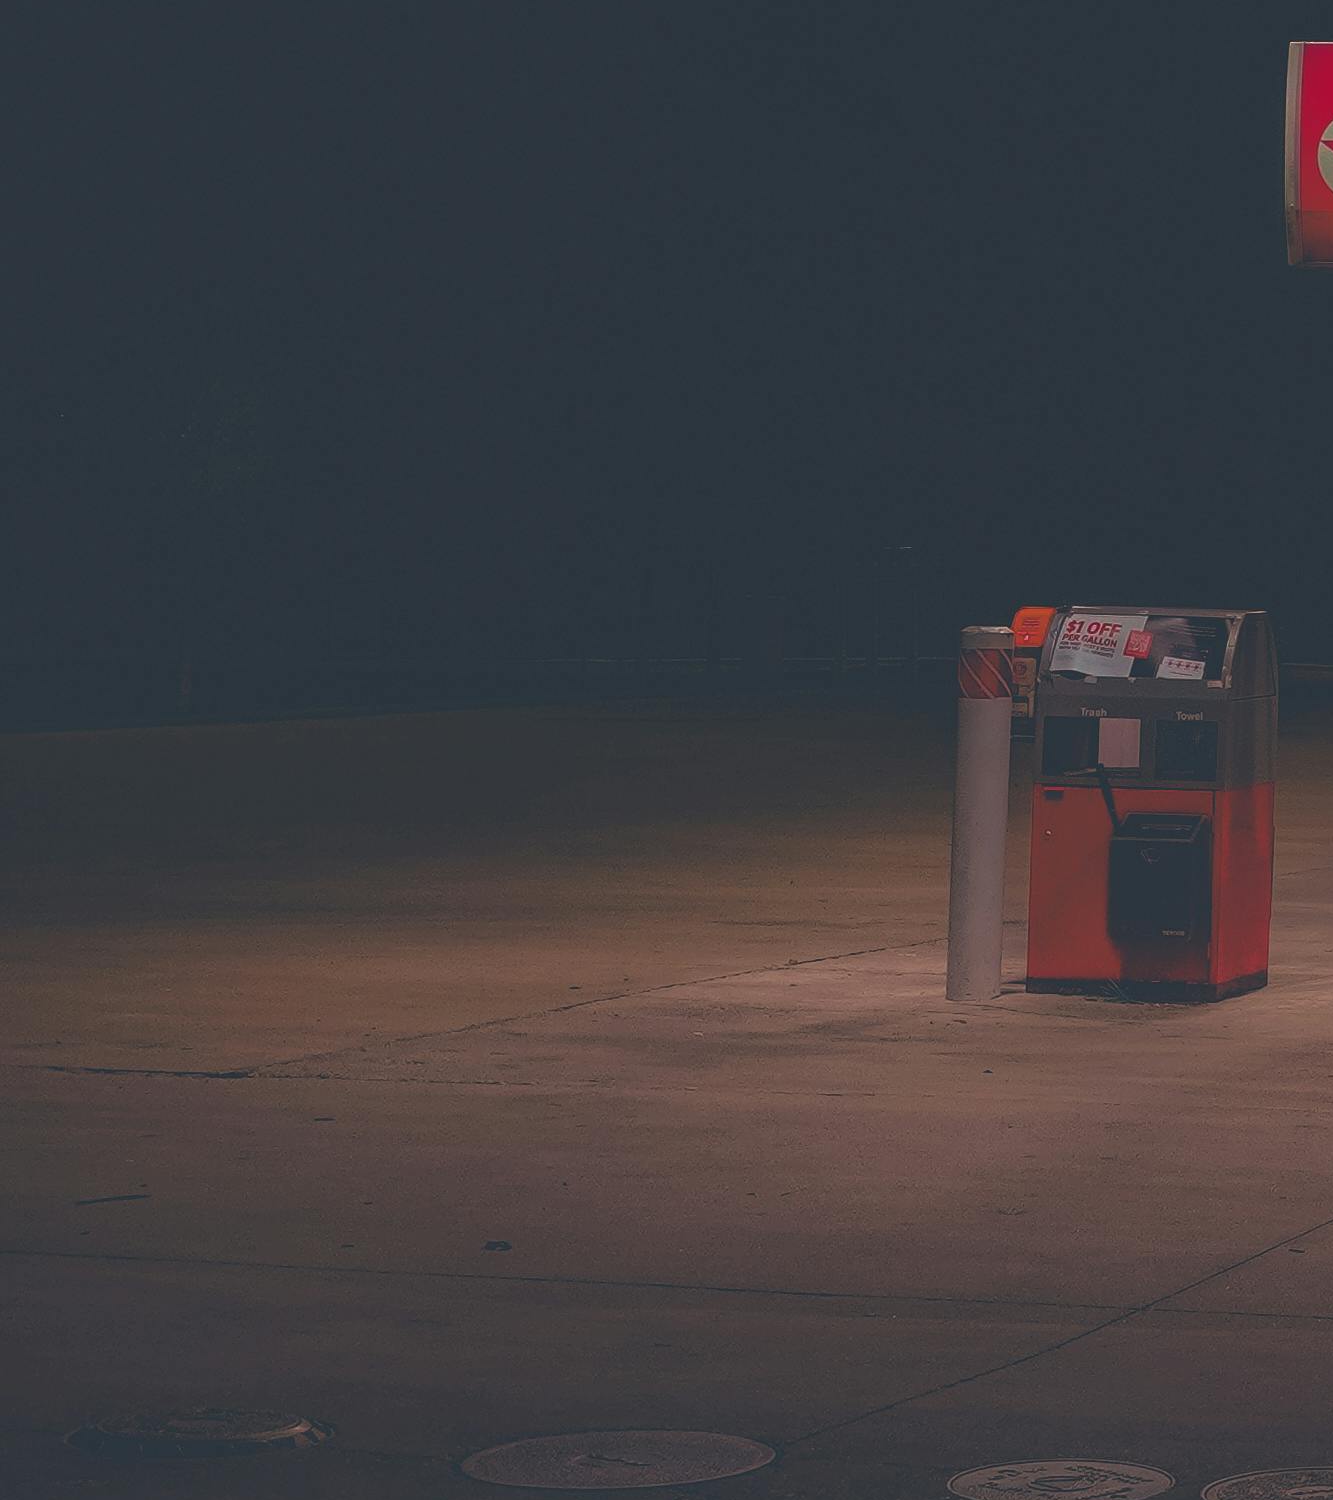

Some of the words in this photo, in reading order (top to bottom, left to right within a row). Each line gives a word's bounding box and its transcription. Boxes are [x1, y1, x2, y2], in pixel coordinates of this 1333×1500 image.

[1066, 619, 1085, 634] $1
[1087, 621, 1122, 637] OFF
[1061, 633, 1081, 641] PER
[1082, 634, 1118, 648] GALLON
[1080, 707, 1108, 717] Trash
[1176, 711, 1203, 721] Towel
